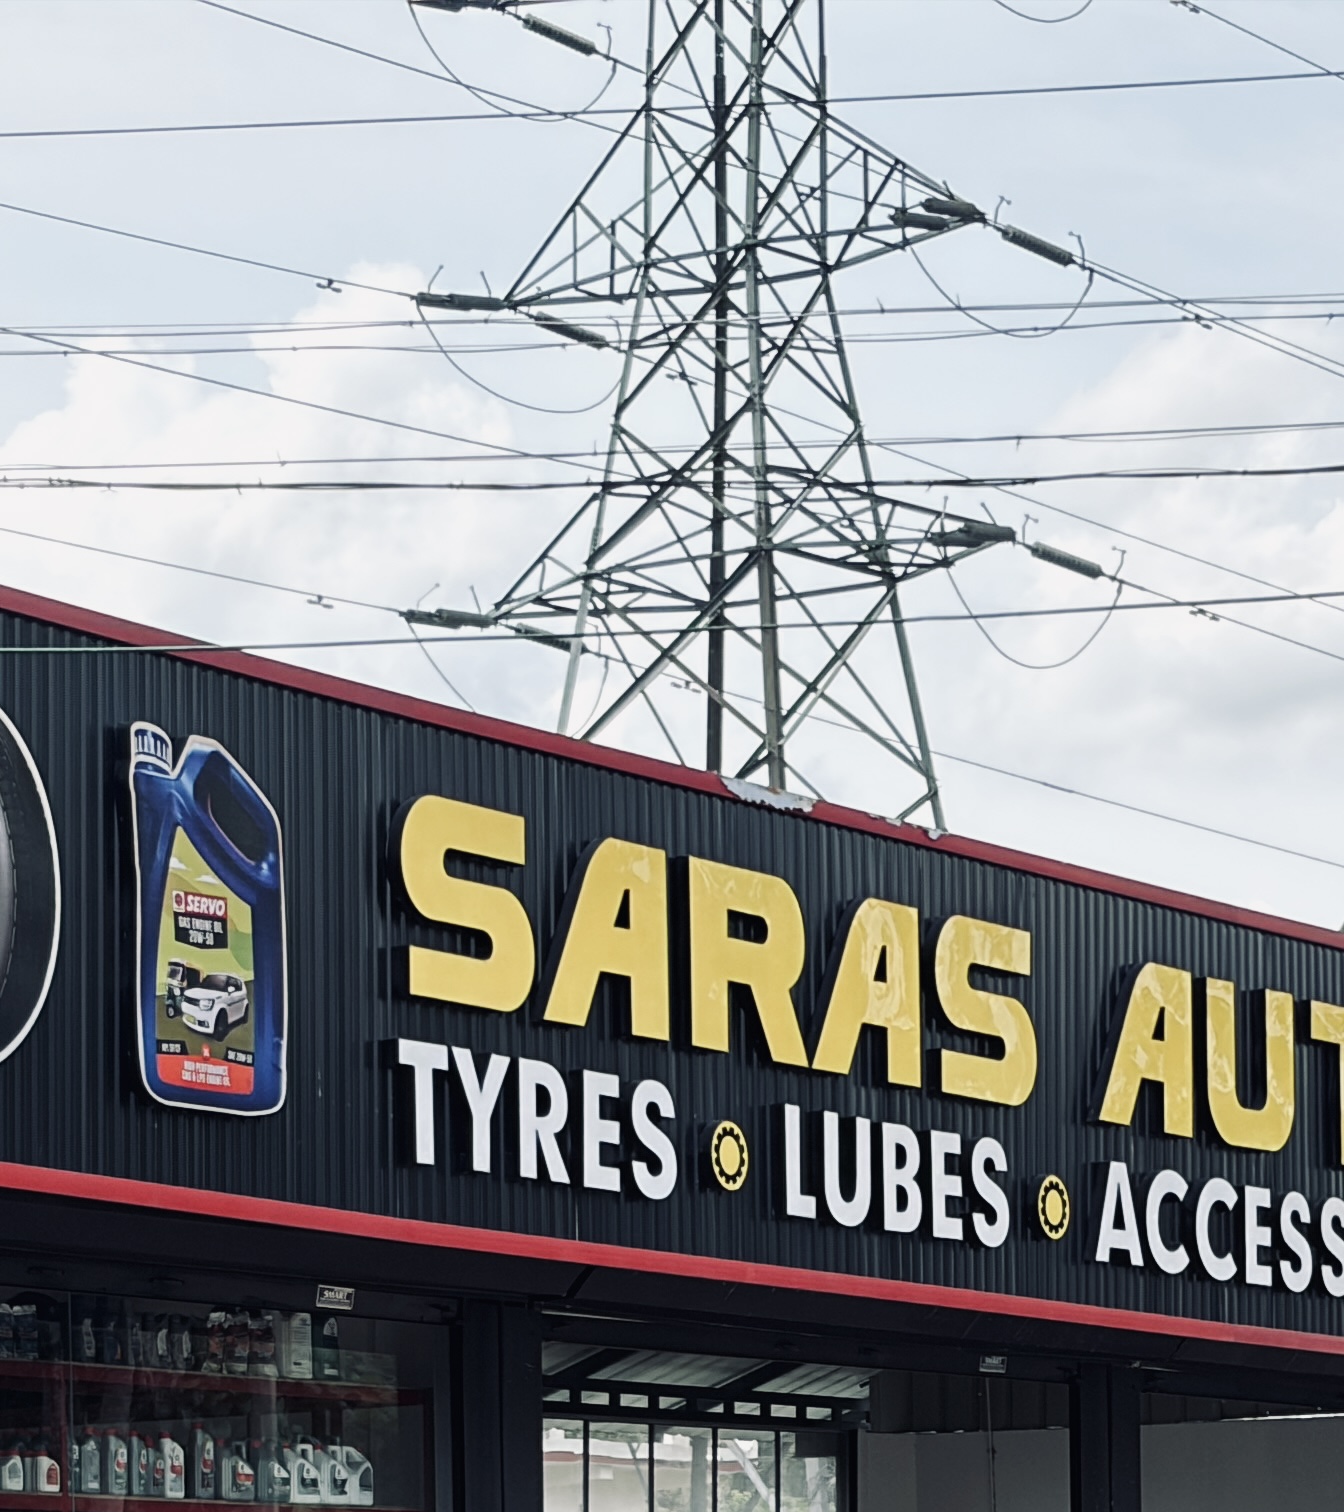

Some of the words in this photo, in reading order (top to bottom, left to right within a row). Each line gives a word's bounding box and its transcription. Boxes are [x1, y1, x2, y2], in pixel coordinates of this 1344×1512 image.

[186, 894, 225, 916] SERVO
[400, 794, 1038, 1106] SARAS
[398, 1037, 678, 1200] TYRES
[783, 1103, 1010, 1249] LUBES
